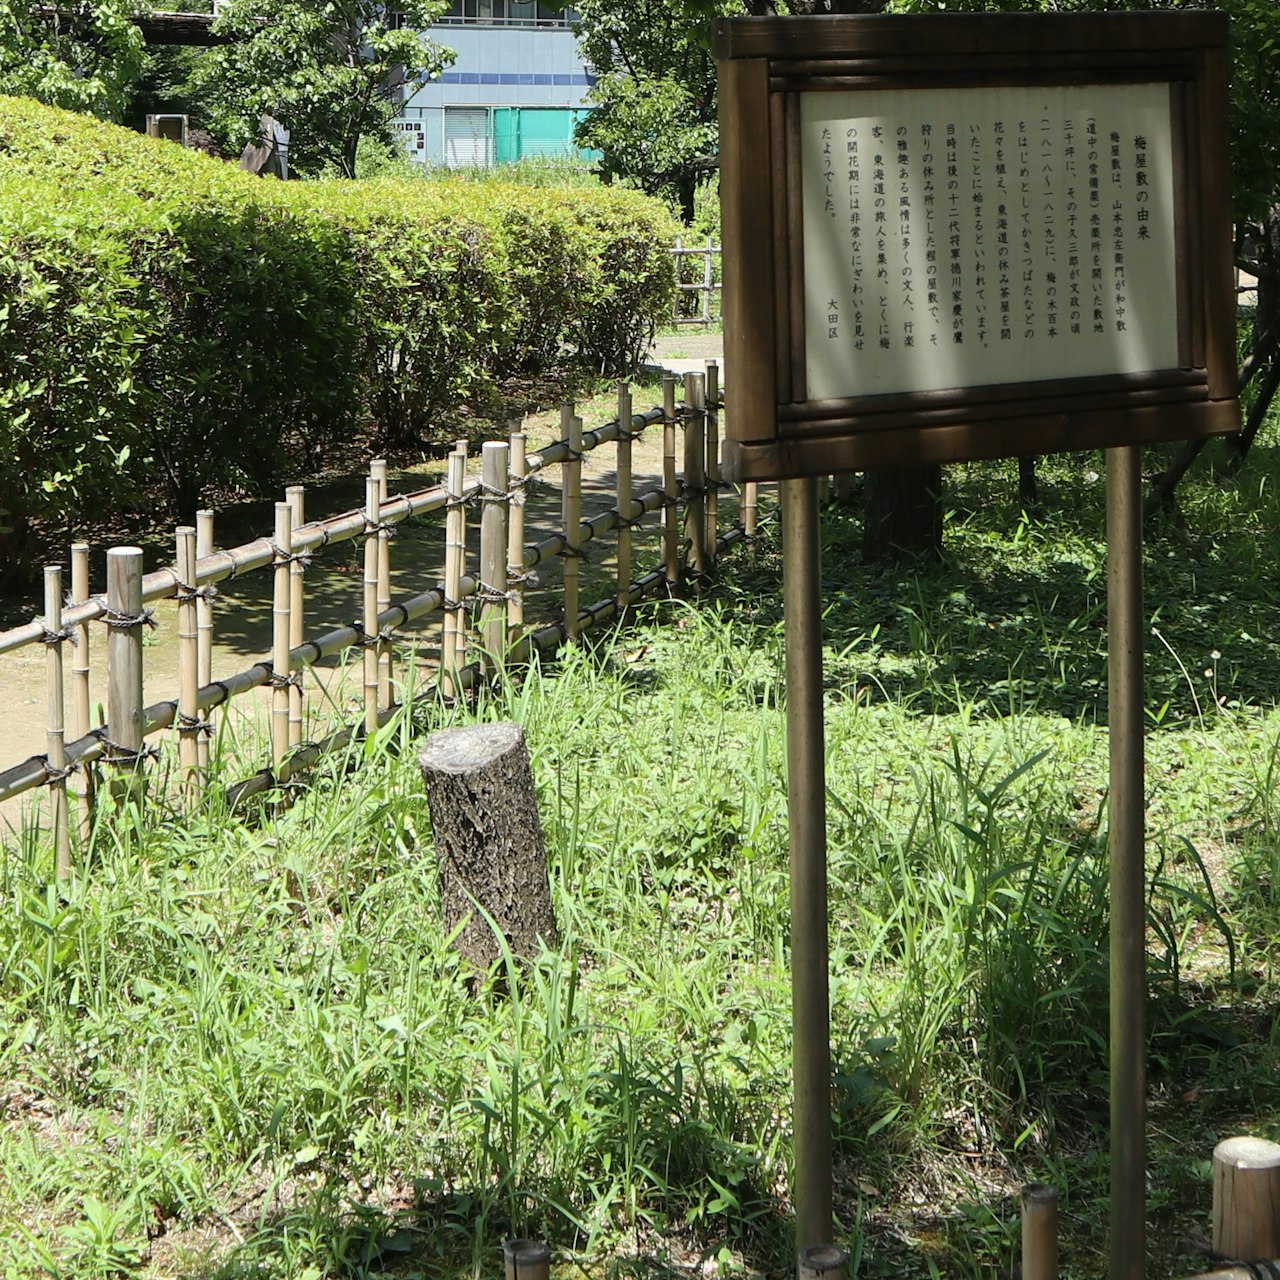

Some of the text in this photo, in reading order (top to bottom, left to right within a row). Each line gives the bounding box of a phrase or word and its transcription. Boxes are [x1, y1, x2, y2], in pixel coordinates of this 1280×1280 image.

[822, 128, 839, 339] たようでした。 大田区
[969, 125, 988, 348] いたことに始まるといわれています。
[1018, 121, 1035, 339] をはじめとしてかきつばたなどの
[1133, 135, 1151, 241] 梅屋敷の由来
